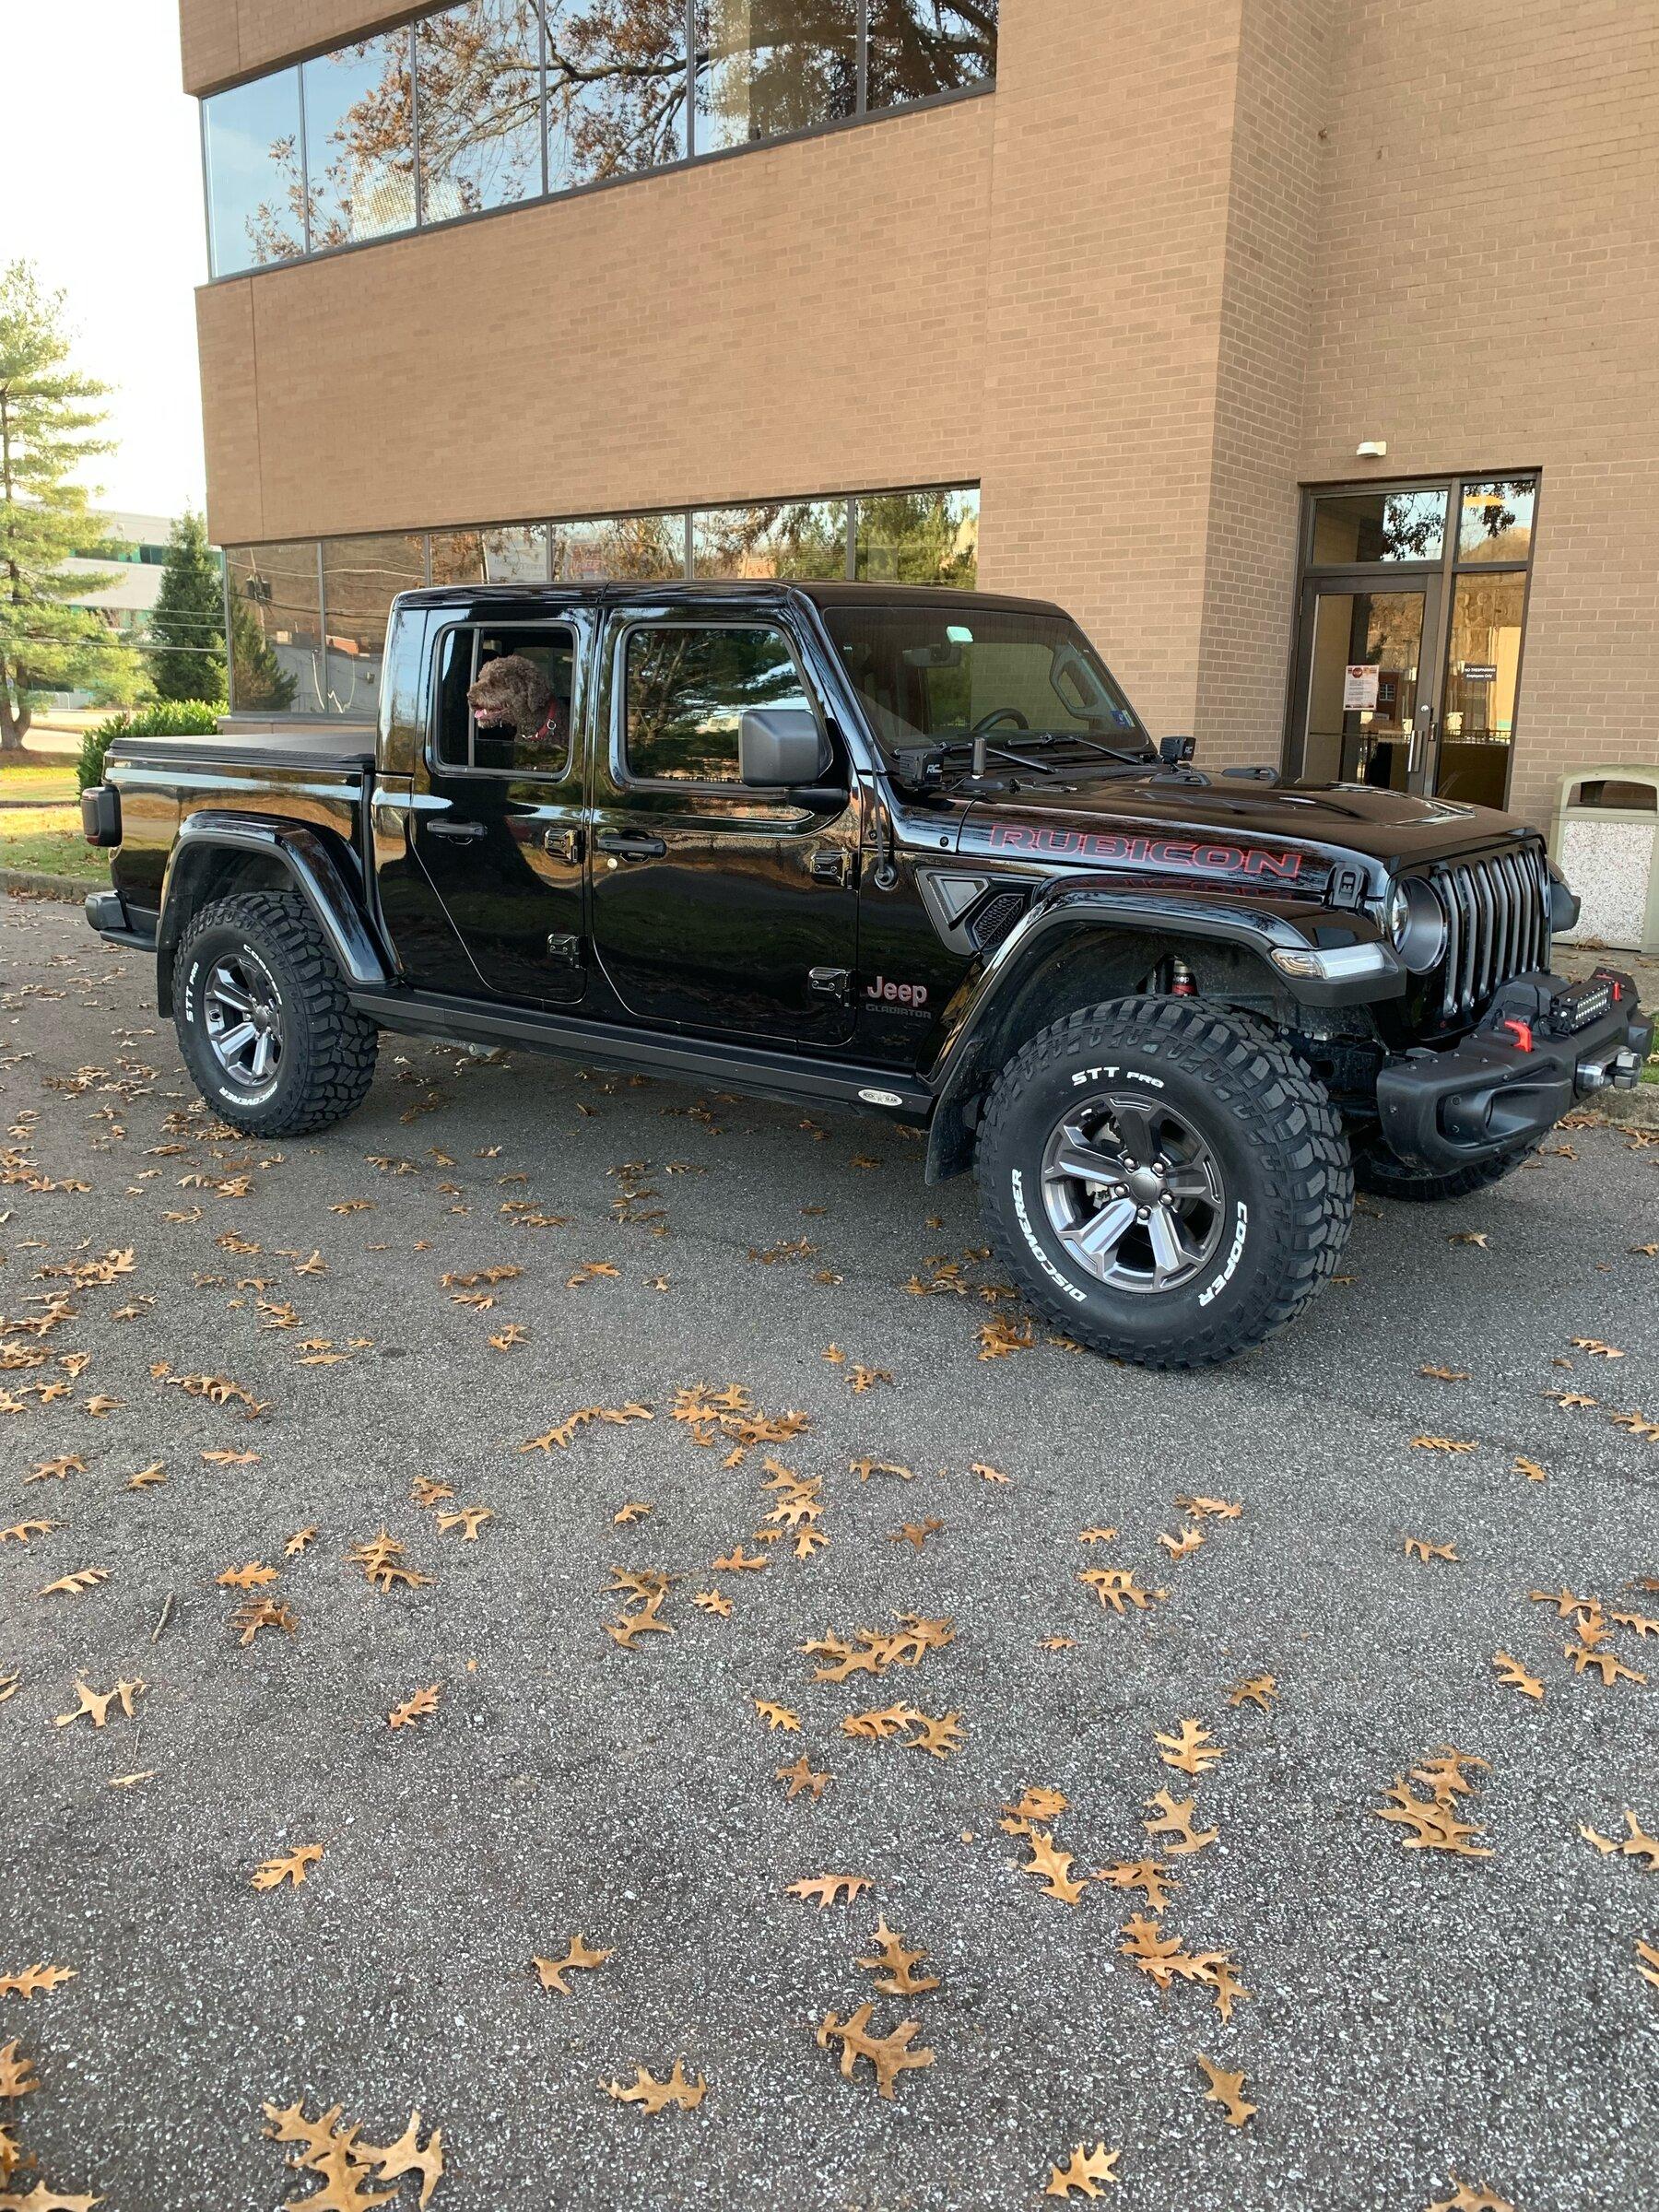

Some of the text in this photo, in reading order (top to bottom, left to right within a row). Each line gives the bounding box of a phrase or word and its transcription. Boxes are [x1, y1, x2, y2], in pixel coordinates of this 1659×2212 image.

[926, 764, 943, 774] RC
[989, 825, 1302, 877] RUBICON
[185, 985, 194, 1023] STT
[866, 975, 928, 1007] Jeep
[865, 1003, 933, 1019] GLADIATOR
[218, 1081, 278, 1106] DISCOVERER
[1071, 1066, 1165, 1089] STT PRO
[1011, 1169, 1088, 1303] DISCOVERER
[1197, 1200, 1248, 1307] COOPER
